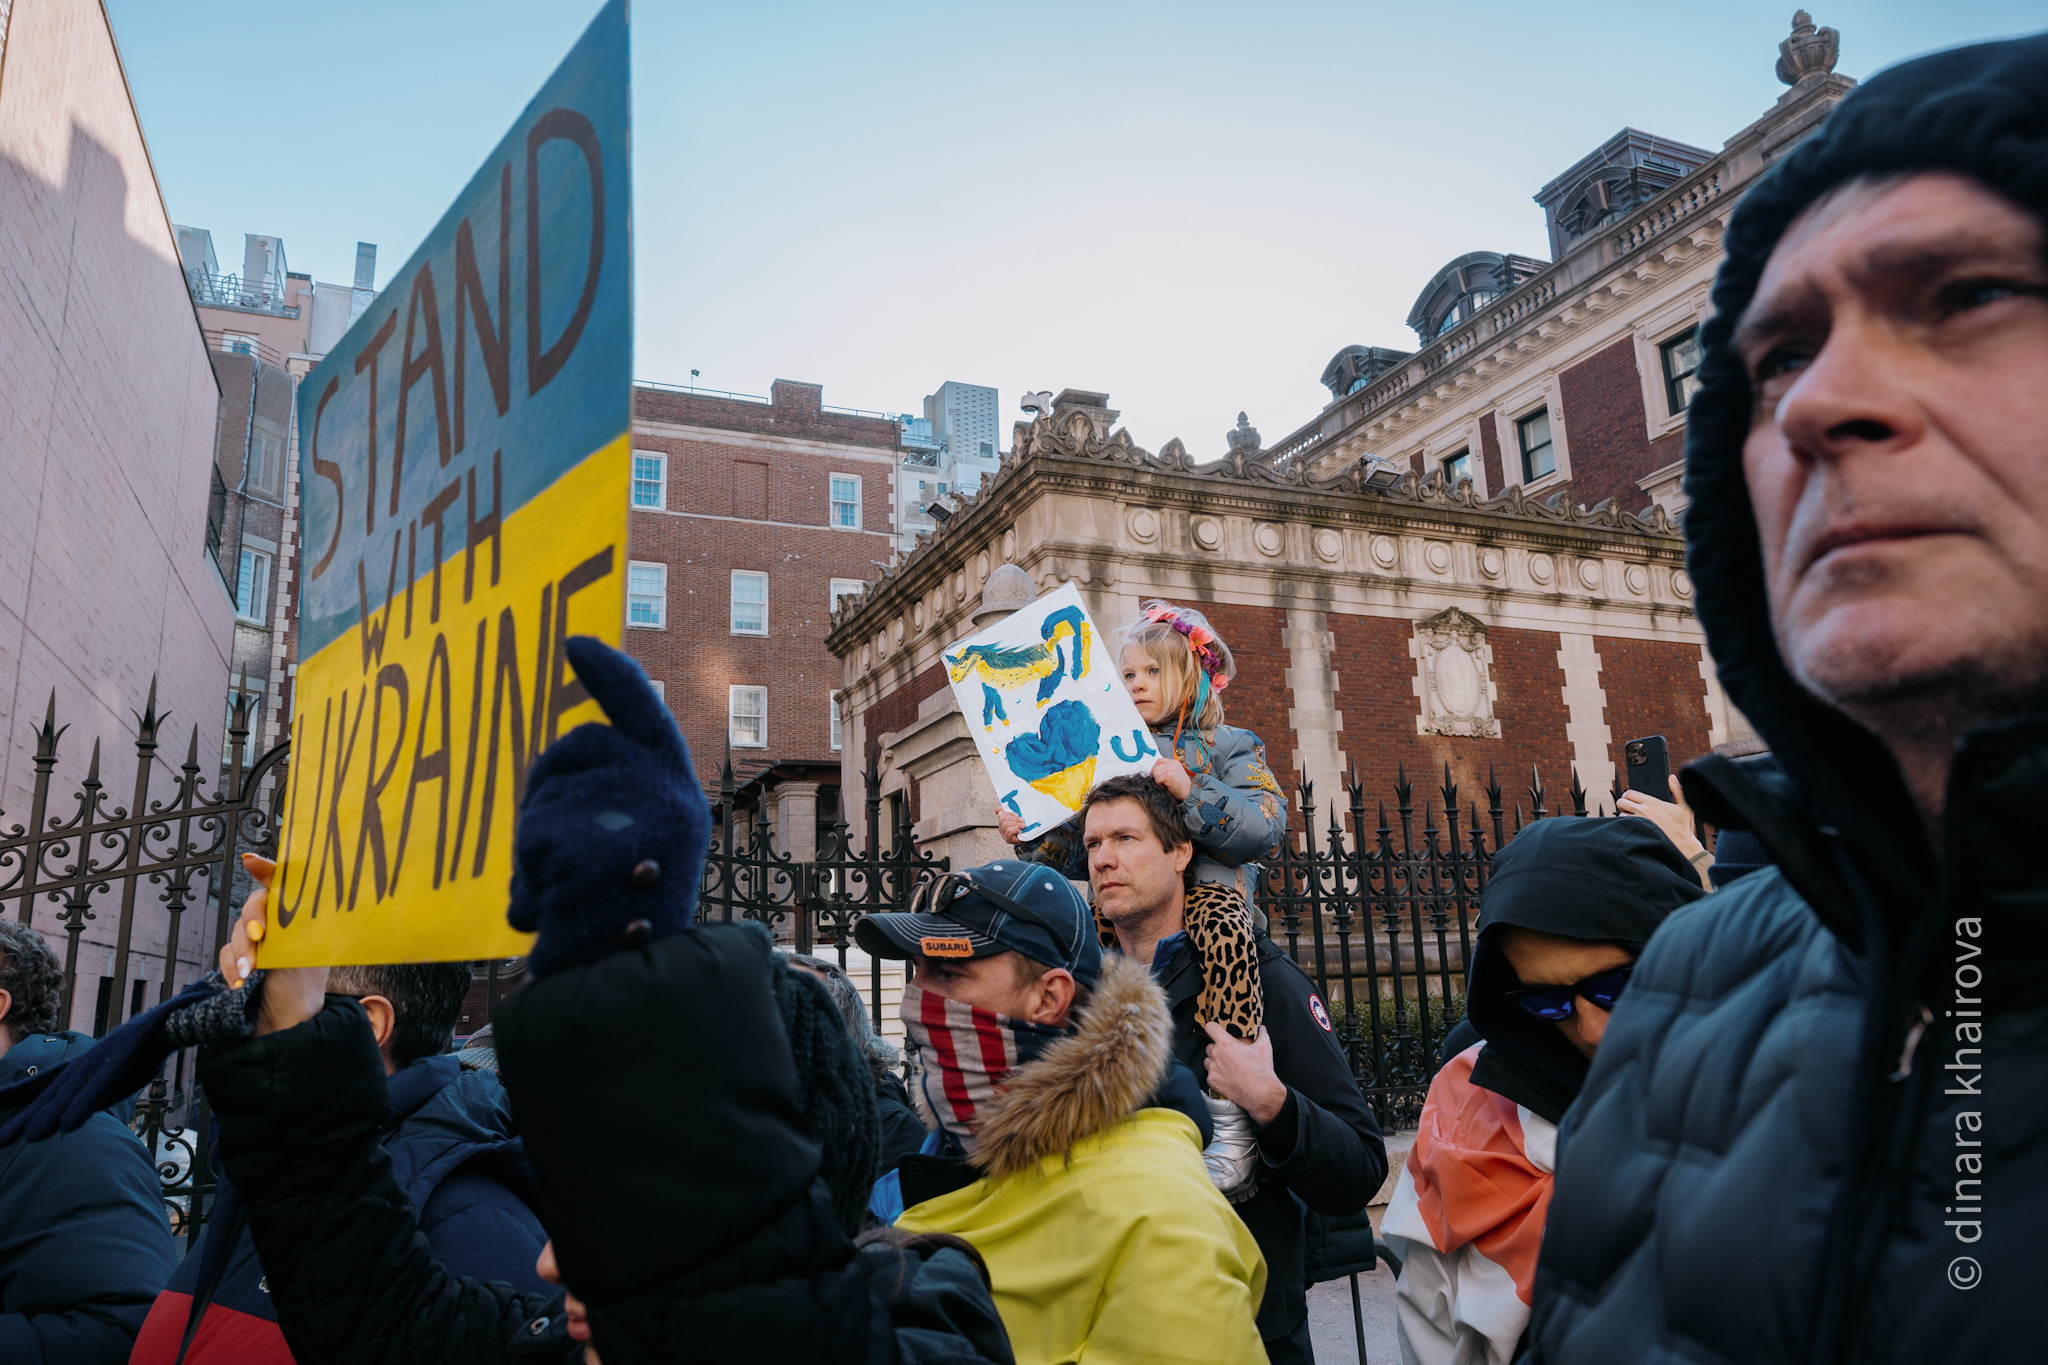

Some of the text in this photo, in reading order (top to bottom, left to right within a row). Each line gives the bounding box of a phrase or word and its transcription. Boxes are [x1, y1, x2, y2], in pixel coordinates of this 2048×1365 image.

[312, 107, 604, 581] STAND
[358, 448, 502, 676] WITH
[925, 942, 968, 951] SUBARU
